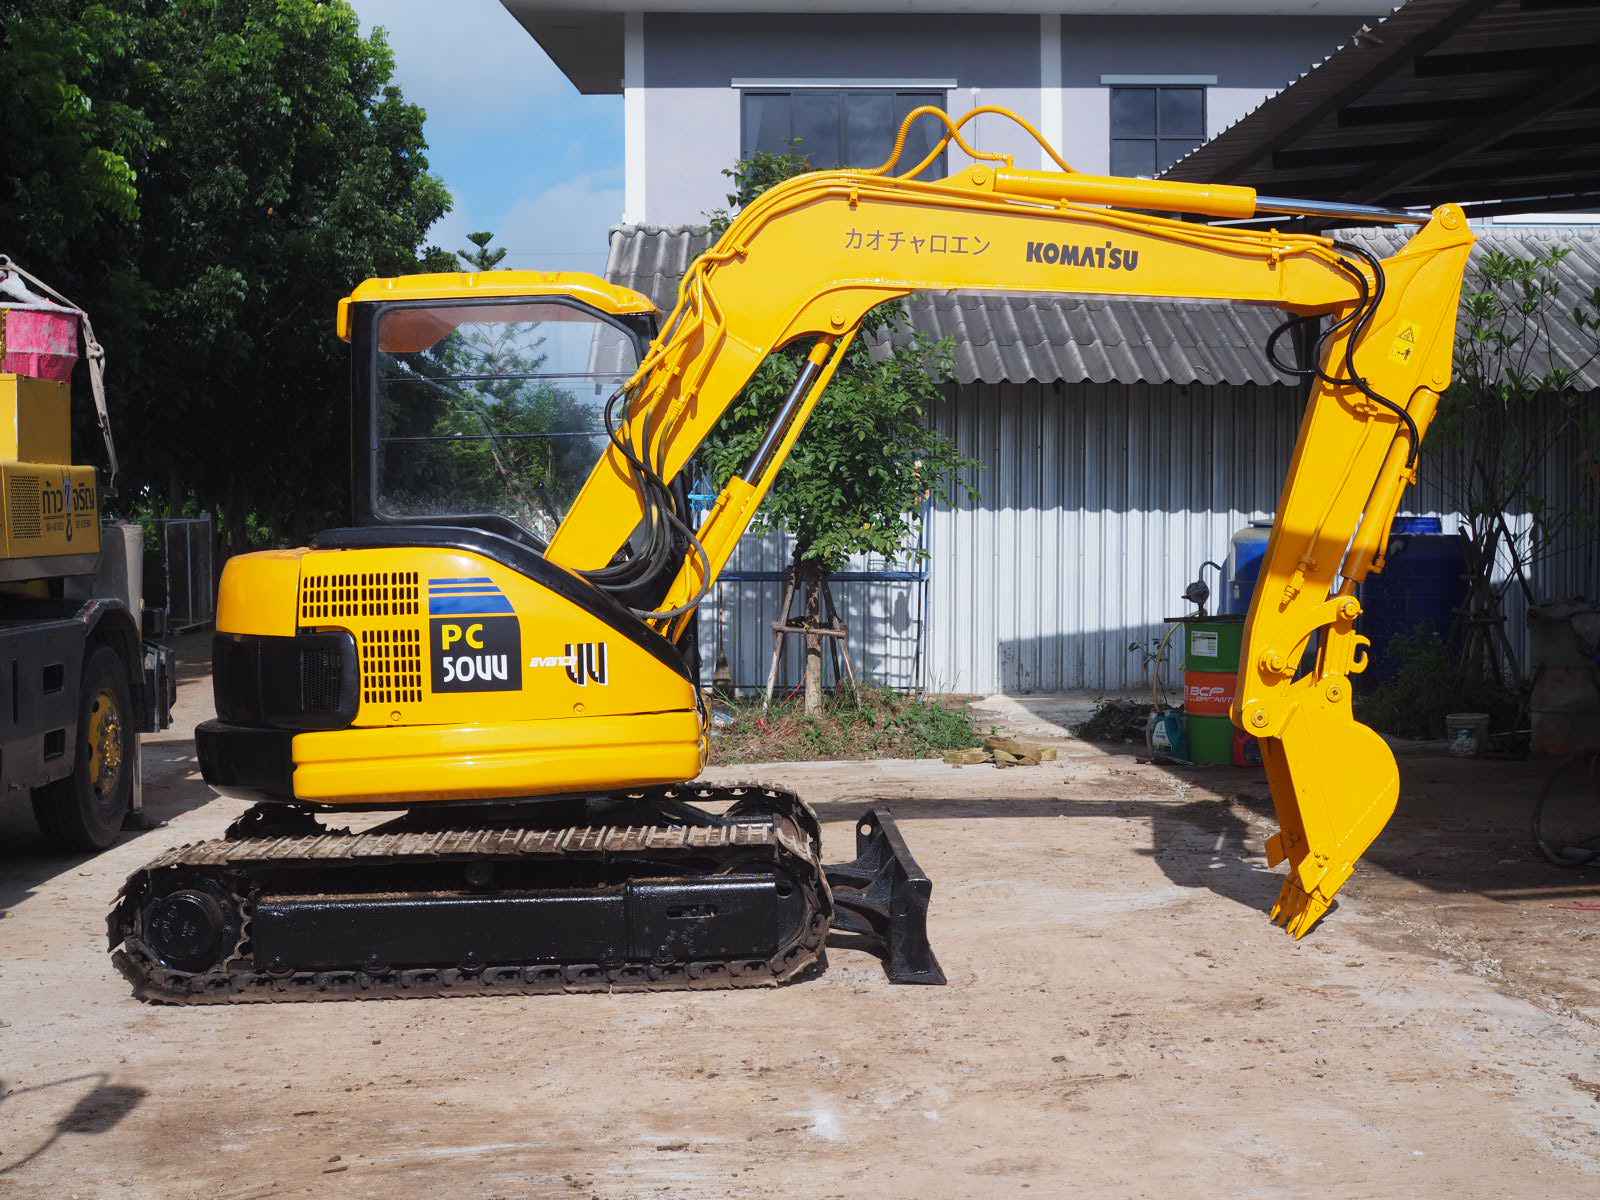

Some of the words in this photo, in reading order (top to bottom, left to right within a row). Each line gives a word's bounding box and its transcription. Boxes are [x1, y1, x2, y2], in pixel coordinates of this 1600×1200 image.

[845, 227, 991, 256] カオチャロエン
[1026, 241, 1139, 271] KOMATSU
[441, 623, 484, 650] PC
[1190, 686, 1225, 697] BCP
